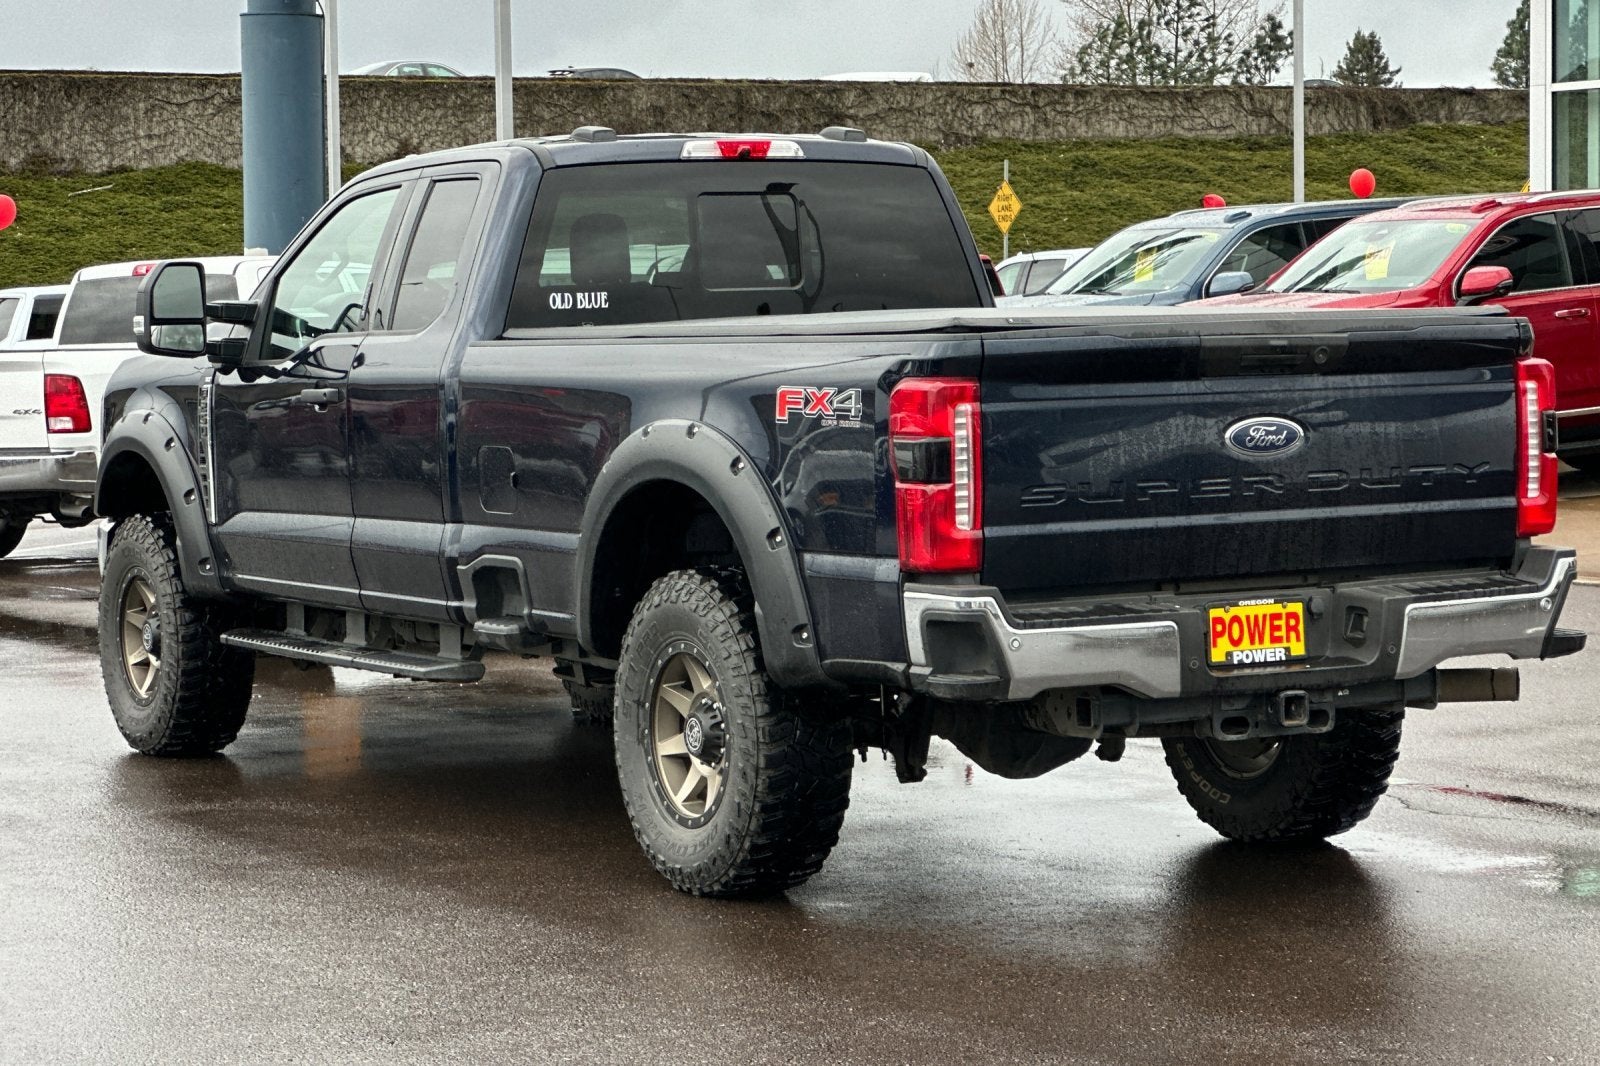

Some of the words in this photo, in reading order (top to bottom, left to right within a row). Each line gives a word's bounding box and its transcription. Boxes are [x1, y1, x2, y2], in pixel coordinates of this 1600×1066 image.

[997, 194, 1013, 202] RIGHT
[997, 204, 1012, 213] LANE
[997, 215, 1013, 223] ENDS
[549, 292, 573, 310] OLD
[576, 291, 609, 309] BLUE
[775, 385, 863, 424] FX4
[1245, 425, 1288, 448] Ford
[1020, 473, 1285, 508] SUPER
[1307, 461, 1491, 493] DUTY
[1238, 598, 1275, 607] OREGON
[1211, 611, 1302, 649] POWER
[1232, 647, 1287, 665] POWER
[1176, 742, 1233, 805] COOPER
